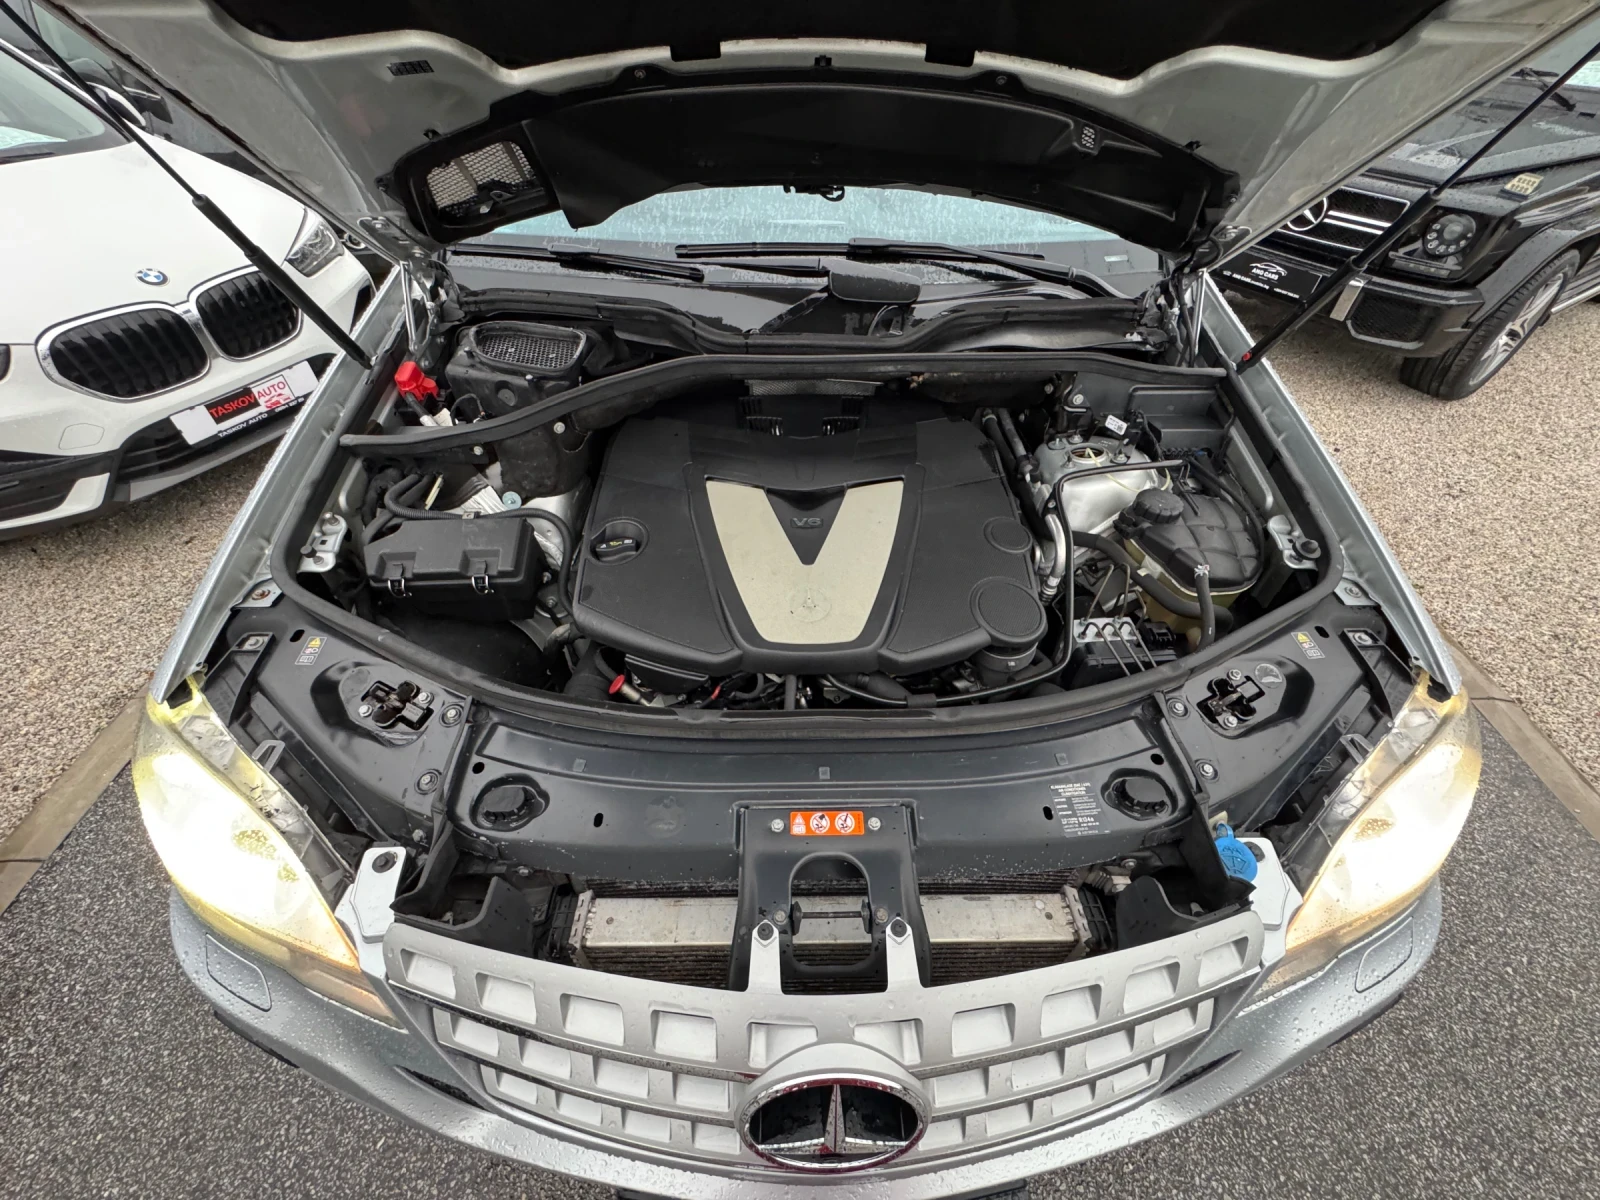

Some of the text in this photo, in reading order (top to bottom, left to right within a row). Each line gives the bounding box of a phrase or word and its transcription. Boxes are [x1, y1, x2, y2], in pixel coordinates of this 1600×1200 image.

[209, 393, 256, 419] TASKOV
[257, 381, 286, 400] AUTO
[218, 413, 268, 438] TASKOV AUTO
[792, 517, 822, 527] V6
